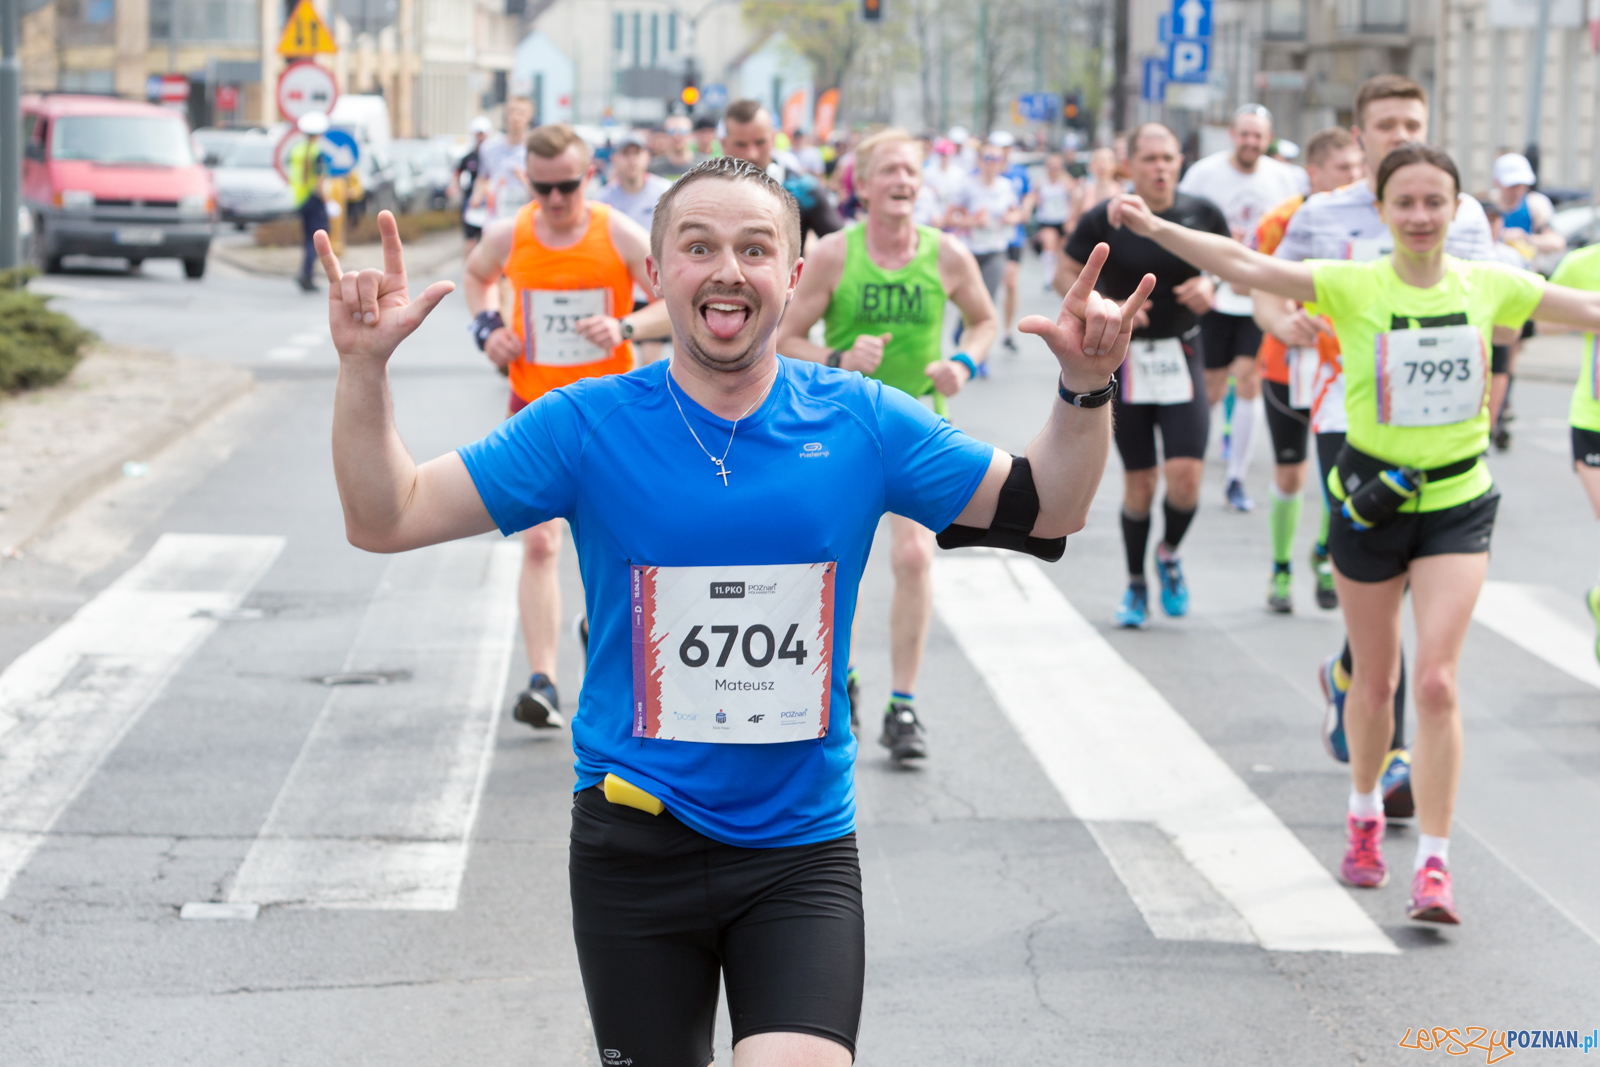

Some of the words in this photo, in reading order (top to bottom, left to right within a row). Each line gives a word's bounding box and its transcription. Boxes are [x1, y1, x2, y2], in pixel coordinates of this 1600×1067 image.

[1174, 42, 1203, 78] P
[863, 283, 922, 311] BTM
[1403, 358, 1471, 385] 7993
[679, 623, 808, 668] 6704
[715, 679, 775, 691] Mateusz
